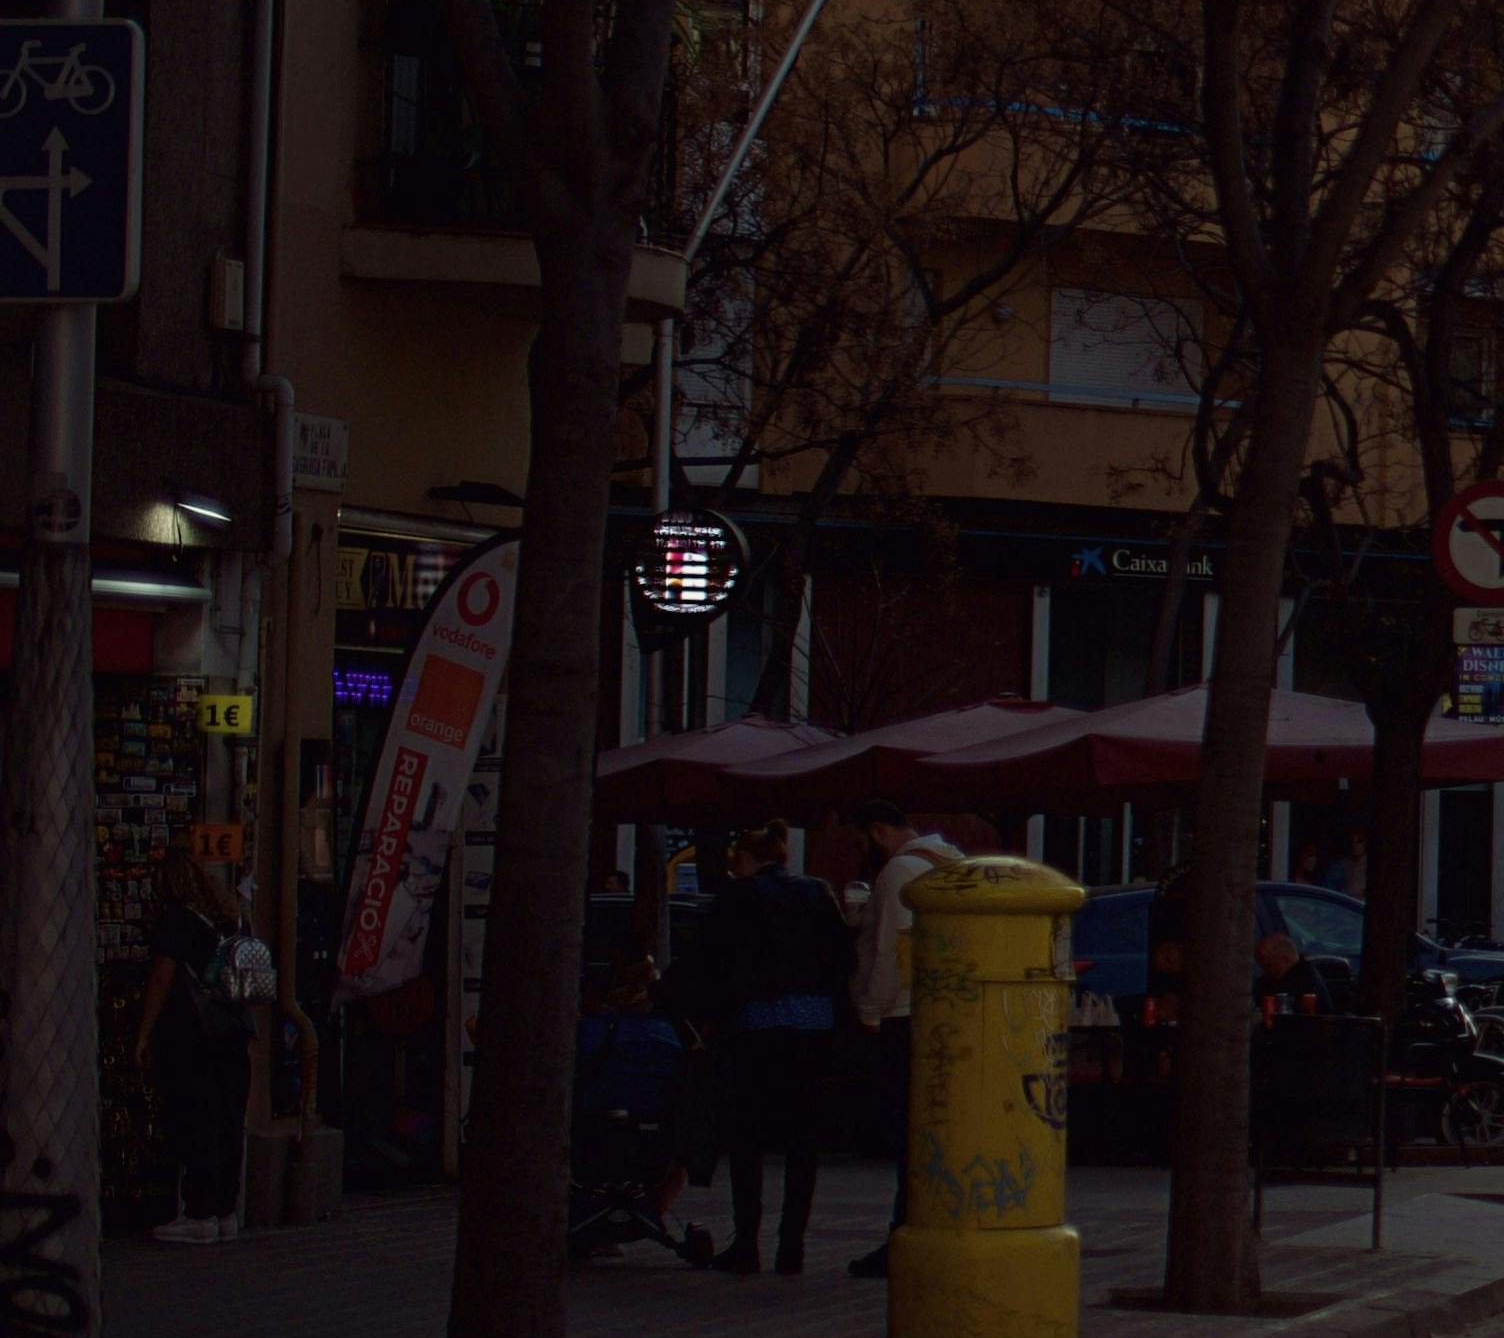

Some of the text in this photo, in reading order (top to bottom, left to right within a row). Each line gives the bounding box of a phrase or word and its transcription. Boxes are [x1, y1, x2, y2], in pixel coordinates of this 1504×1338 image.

[432, 624, 497, 660] vodafone
[204, 703, 240, 728] 1€
[409, 712, 465, 744] orange
[200, 833, 234, 856] 1€
[359, 753, 418, 932] REPARACIÓ
